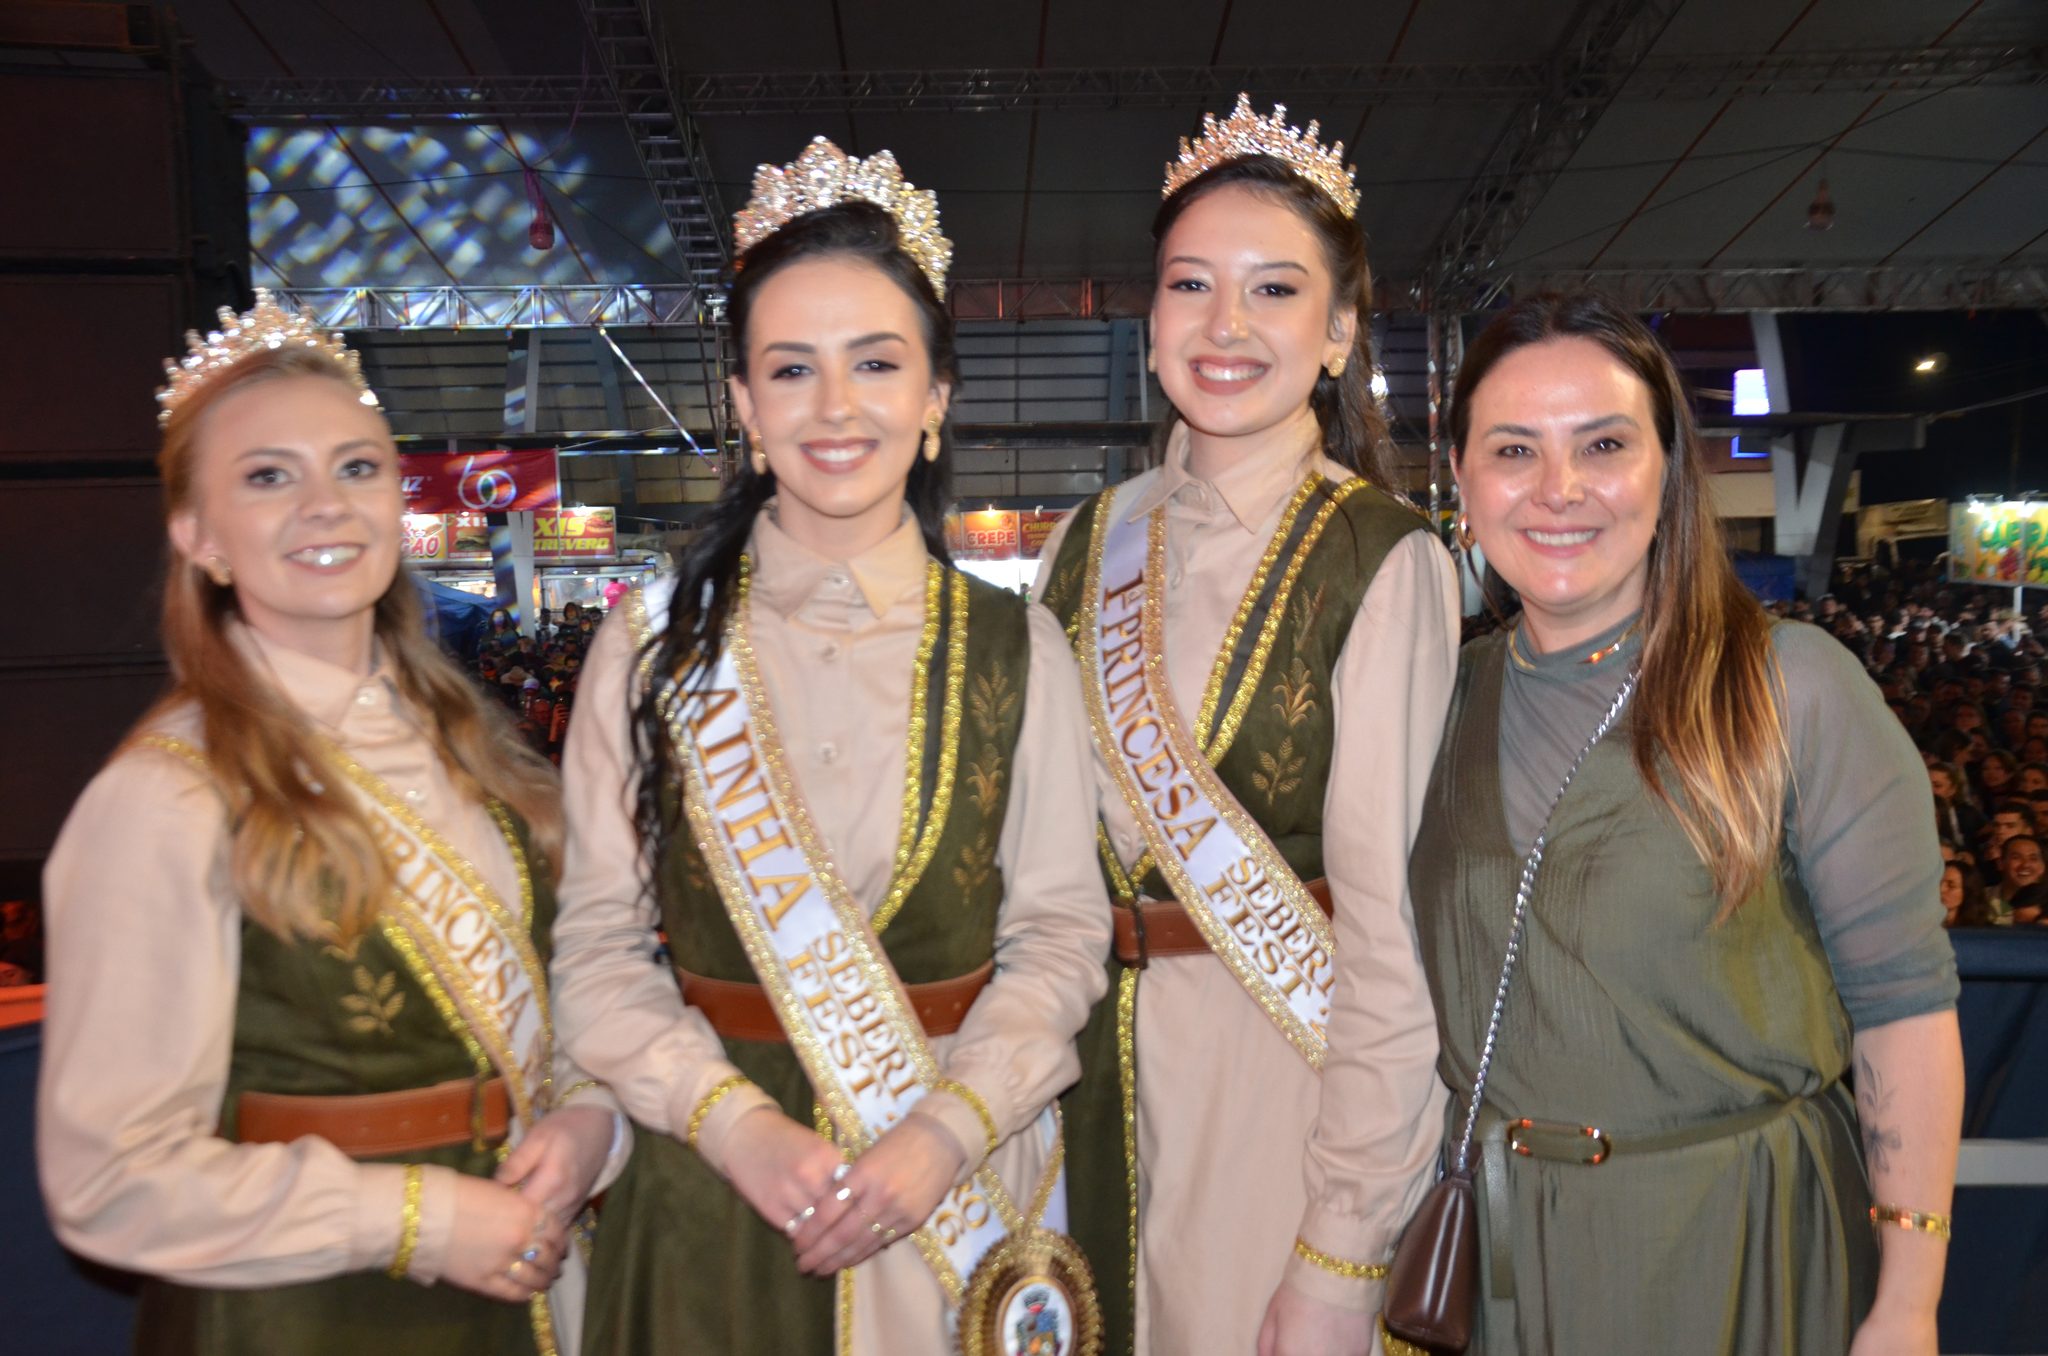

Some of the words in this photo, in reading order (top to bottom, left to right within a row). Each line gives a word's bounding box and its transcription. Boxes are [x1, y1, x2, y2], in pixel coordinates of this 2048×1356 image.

[533, 516, 587, 537] XIS
[966, 530, 1016, 546] CREPE
[1101, 609, 1218, 861] PRINCESA
[1202, 870, 1311, 1000] FEST
[786, 946, 882, 1097] FEST
[814, 930, 917, 1098] SEBERI
